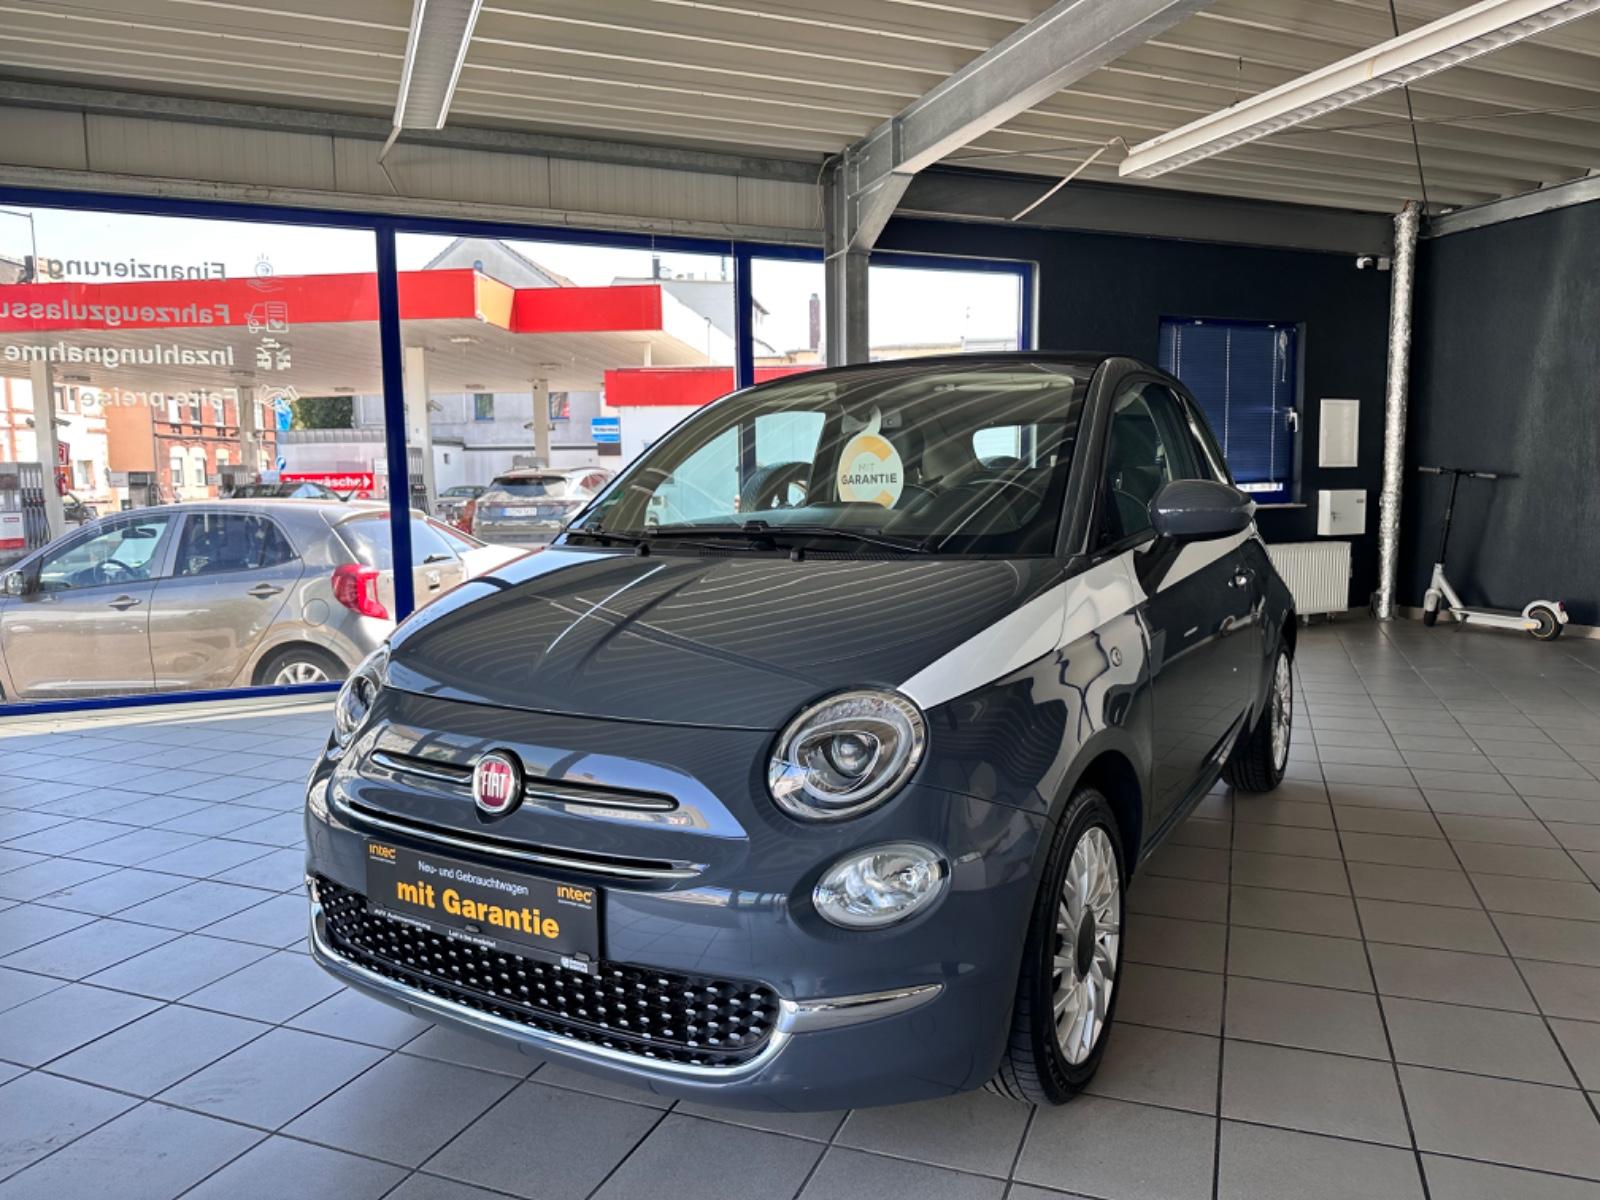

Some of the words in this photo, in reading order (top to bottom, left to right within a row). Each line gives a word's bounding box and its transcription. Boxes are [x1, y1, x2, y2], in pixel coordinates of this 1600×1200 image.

[841, 473, 897, 485] GARANTIE
[481, 771, 508, 799] FIAT
[418, 860, 437, 874] Neu-
[439, 867, 454, 879] und
[455, 869, 529, 896] Gebrauchtwagen
[397, 880, 436, 909] mit
[442, 888, 560, 939] Garantie
